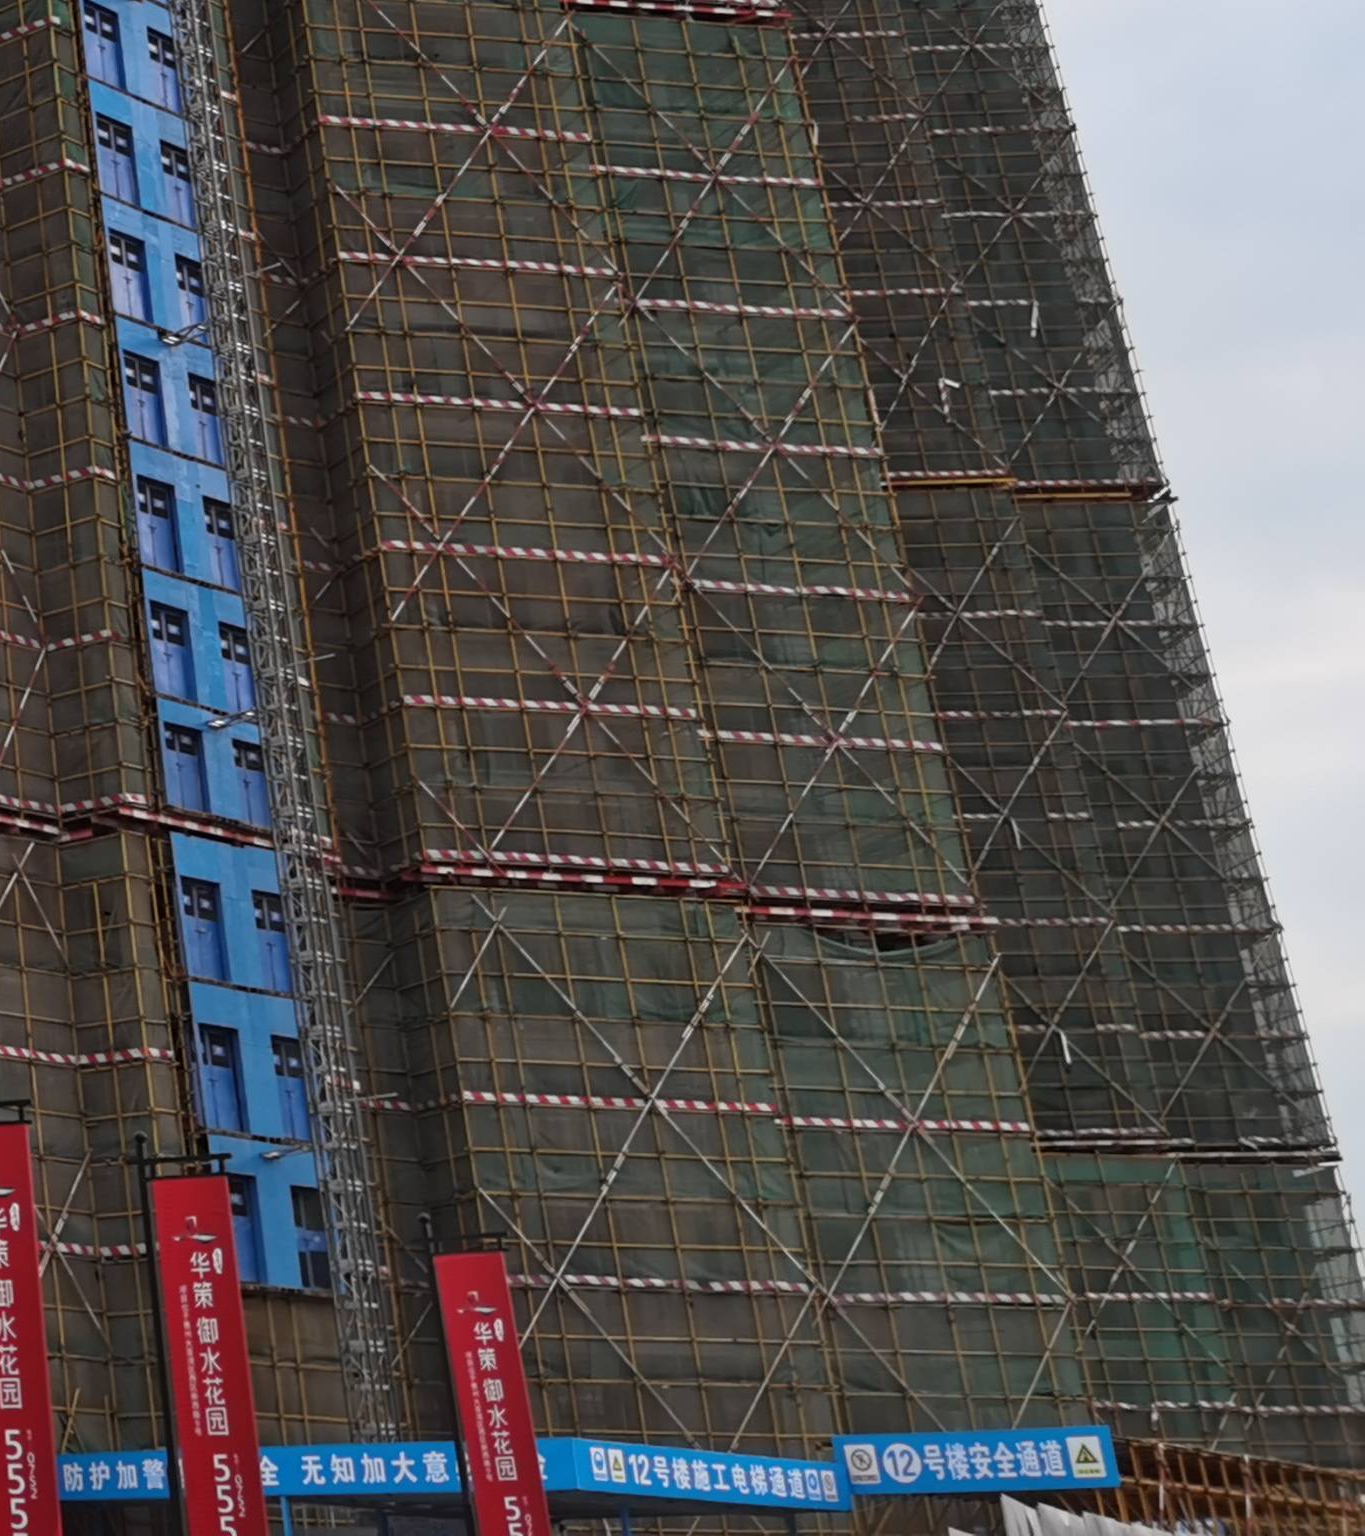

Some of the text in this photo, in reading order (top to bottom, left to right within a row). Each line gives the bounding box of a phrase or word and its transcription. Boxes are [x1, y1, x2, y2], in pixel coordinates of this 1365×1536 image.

[4, 1429, 29, 1536] 555
[628, 1453, 806, 1499] 12号楼施工电梯通道
[884, 1439, 1067, 1482] 12号楼安全通道
